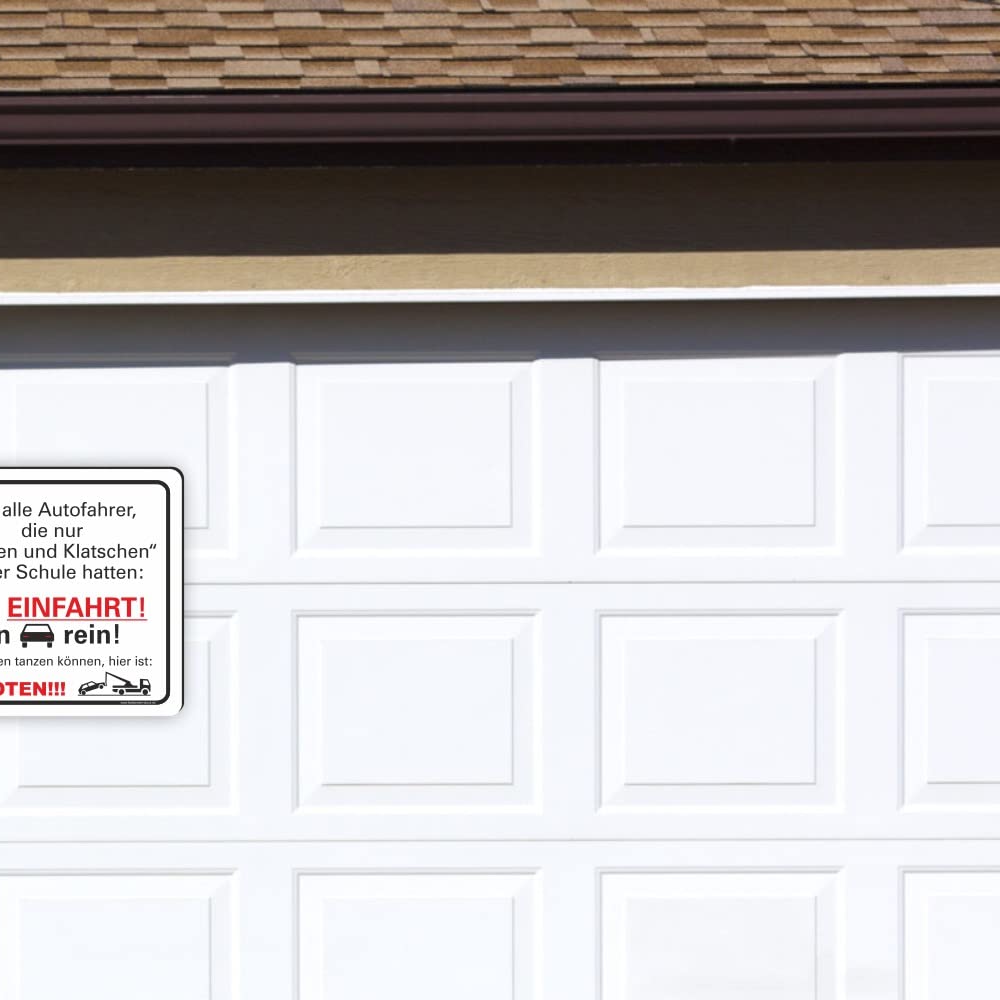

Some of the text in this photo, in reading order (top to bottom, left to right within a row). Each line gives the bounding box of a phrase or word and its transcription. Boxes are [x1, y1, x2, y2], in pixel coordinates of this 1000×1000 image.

[3, 502, 32, 517] alle
[38, 502, 137, 520] Autofahrer,
[21, 523, 83, 538] die nur
[25, 543, 57, 559] und
[64, 543, 157, 559] Klatschen“
[16, 564, 76, 579] Schule
[83, 564, 144, 579] hatten:
[7, 597, 146, 618] EINFAHRT!
[63, 624, 120, 645] rein!
[14, 657, 54, 667] tanzen
[58, 656, 105, 668] können,
[109, 656, 131, 667] hier
[136, 656, 153, 667] ist:
